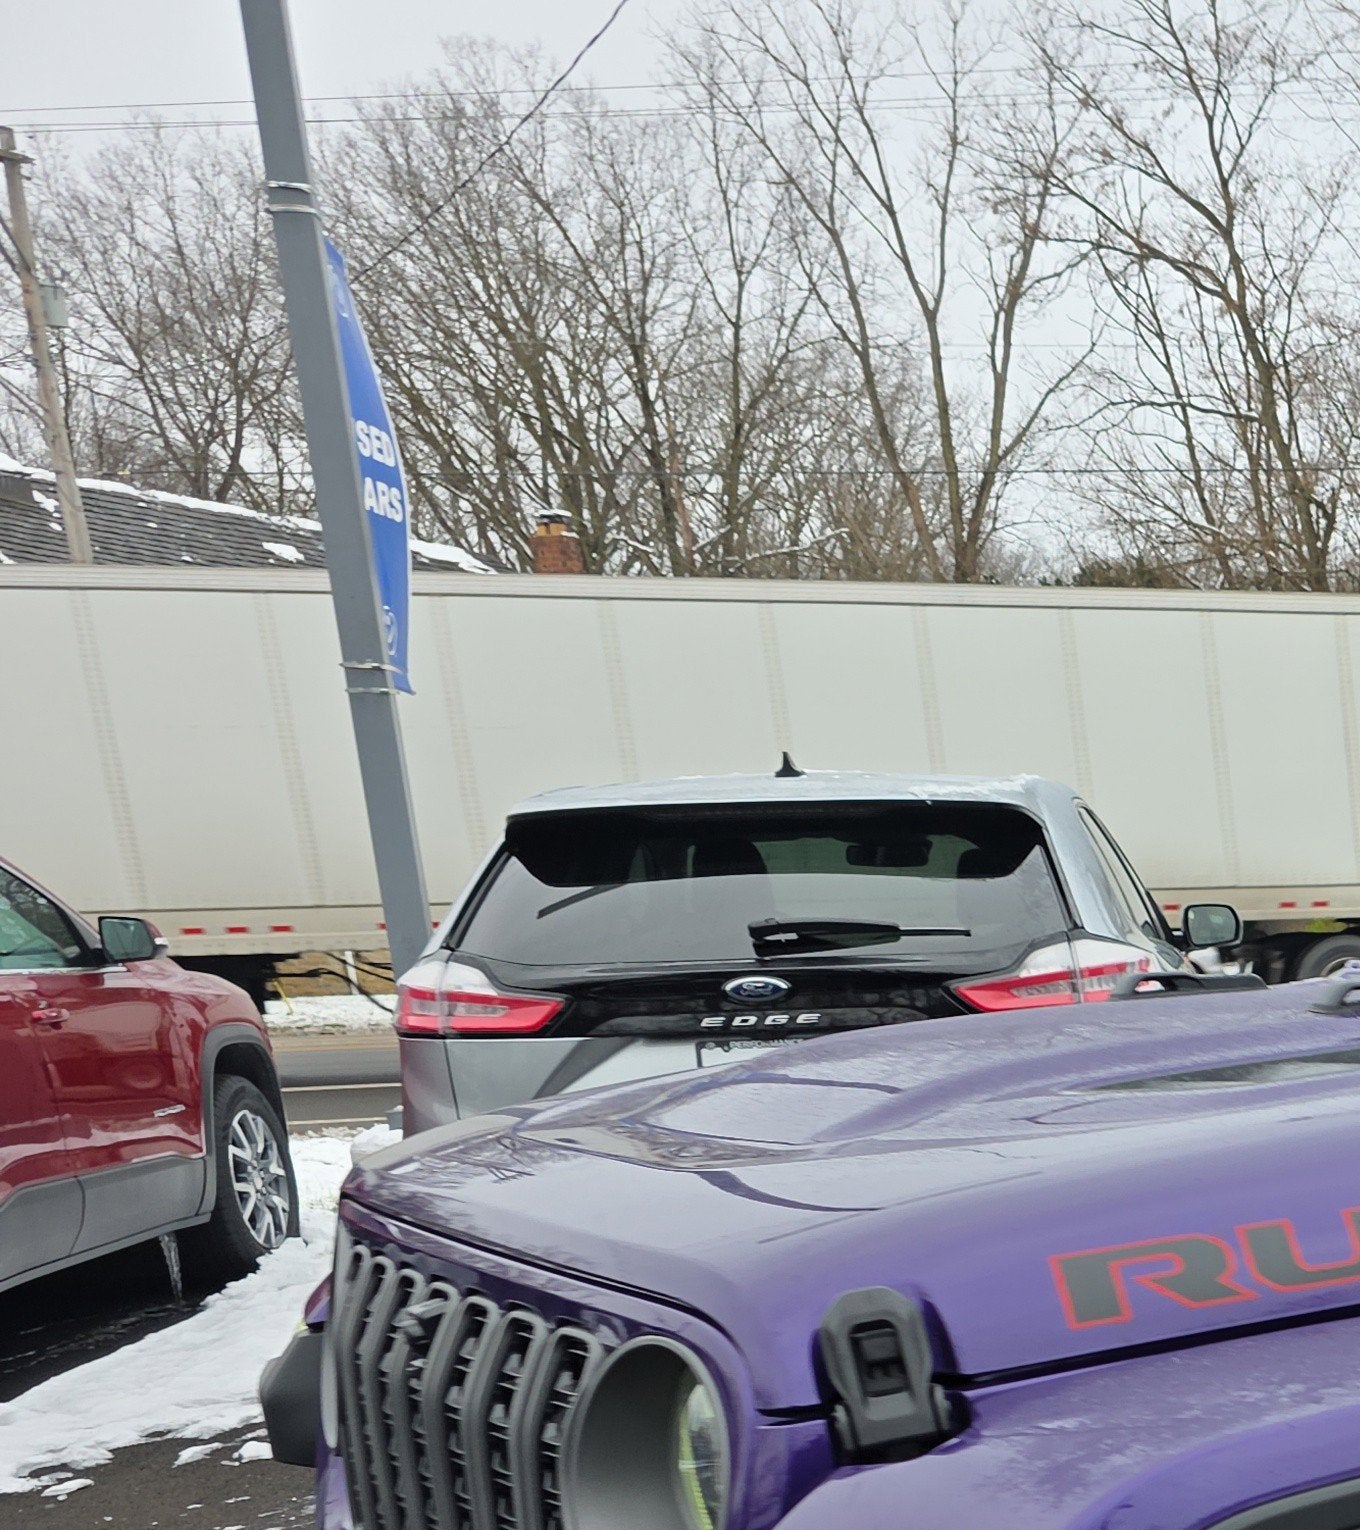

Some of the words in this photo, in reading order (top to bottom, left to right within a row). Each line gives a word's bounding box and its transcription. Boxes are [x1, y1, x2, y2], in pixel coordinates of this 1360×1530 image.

[356, 420, 396, 467] SED
[364, 477, 403, 522] ARS
[700, 1013, 822, 1028] EDGE
